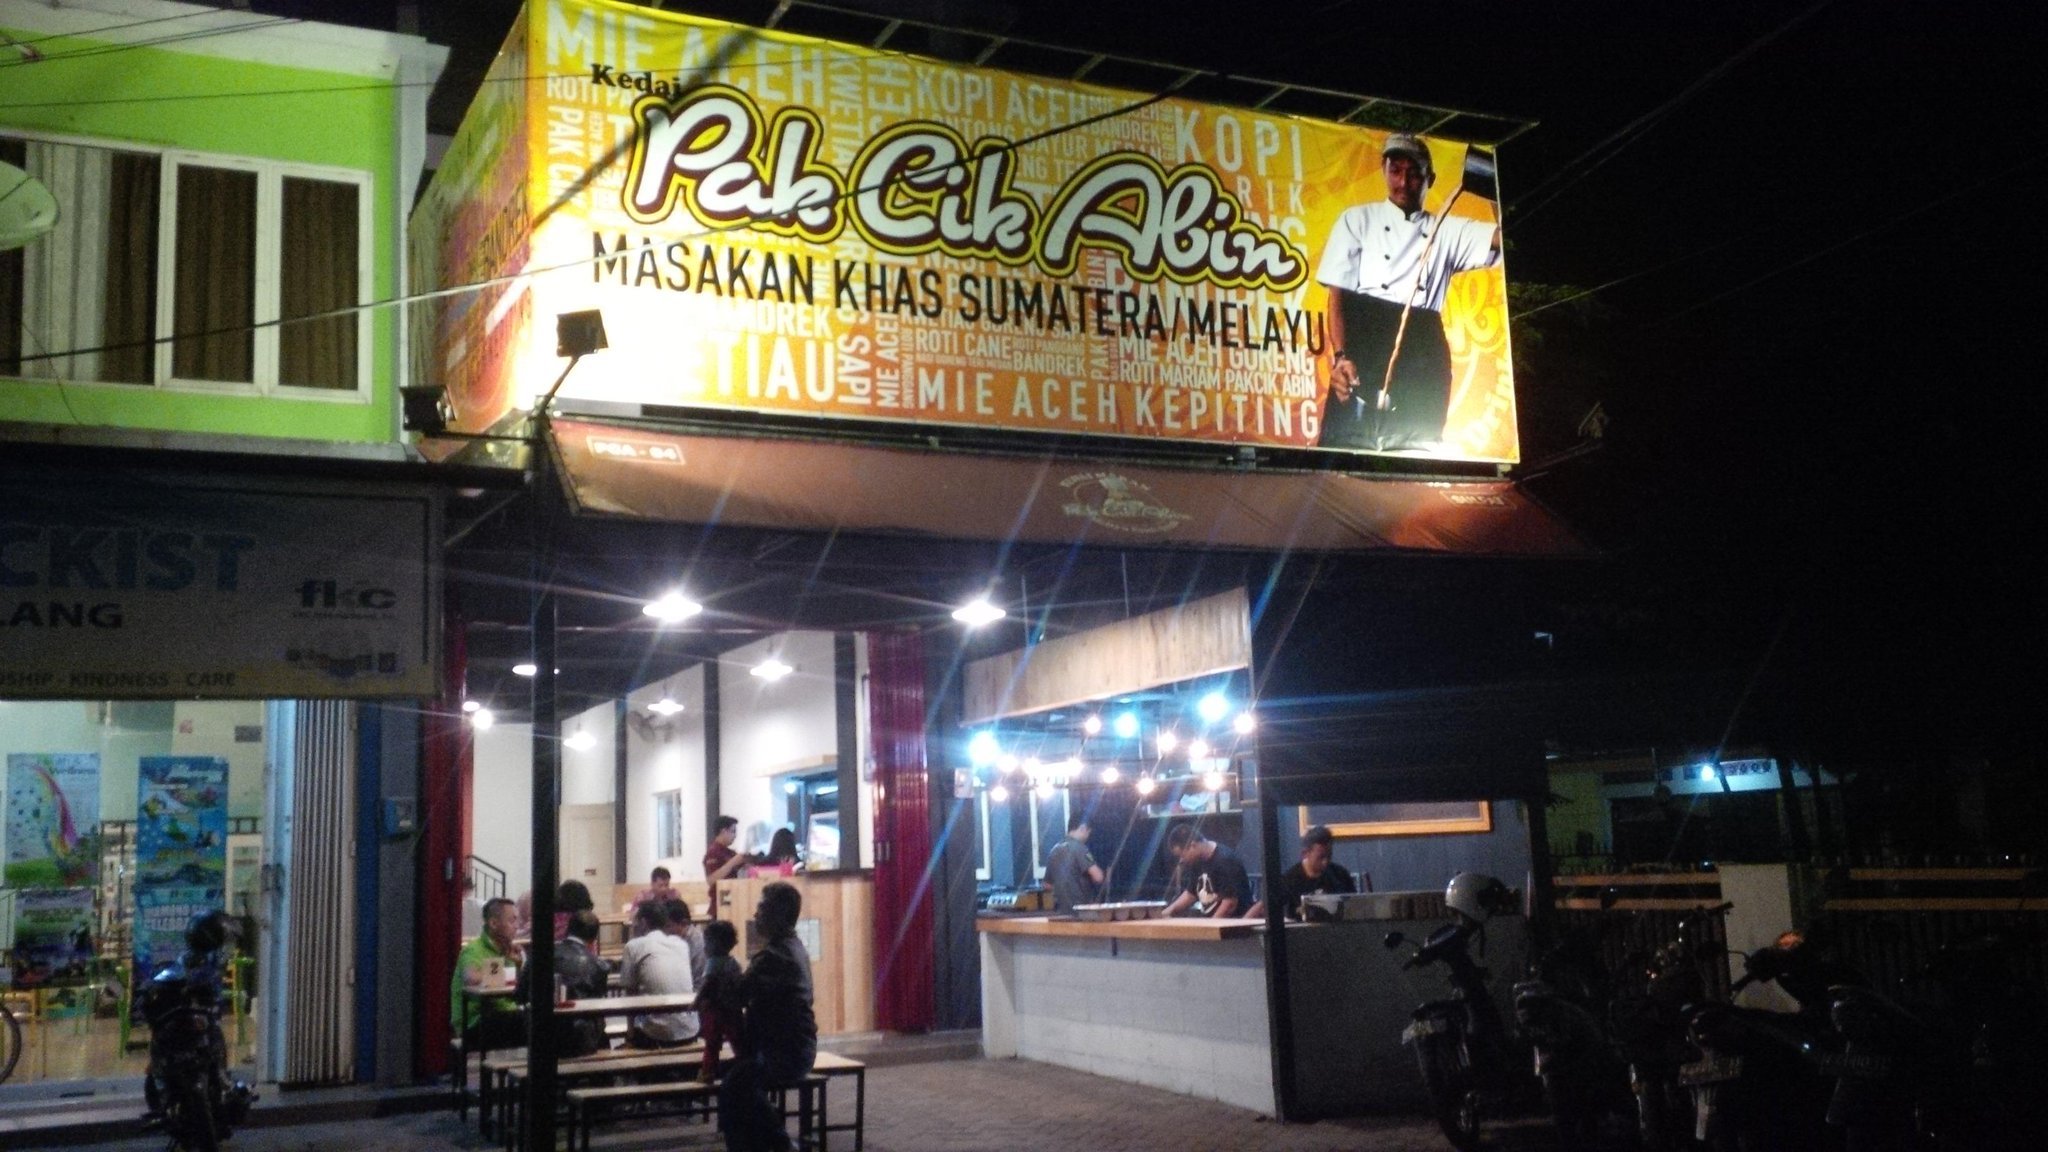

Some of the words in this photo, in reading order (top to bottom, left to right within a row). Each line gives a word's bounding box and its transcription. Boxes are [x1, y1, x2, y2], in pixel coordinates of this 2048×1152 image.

[546, 7, 654, 73] MIE
[591, 63, 681, 99] Kedai
[915, 65, 994, 120] KOPI
[1005, 79, 1087, 127] ACEH
[1174, 105, 1303, 182] KOPI
[629, 91, 839, 229] Pak
[854, 132, 1031, 251] Cik
[1039, 158, 1298, 281] Abin
[592, 231, 814, 306] MASAKAN
[834, 259, 943, 319] KHAS
[958, 272, 1325, 354] SUMATERA/MELAYU
[837, 332, 873, 405] SAPI
[915, 328, 958, 354] ROTI
[964, 332, 1013, 360] CANE
[1013, 351, 1087, 378] BANDREK
[1119, 332, 1159, 364] MIE
[1166, 331, 1222, 369] ACEH
[1229, 340, 1316, 377] GORENG
[876, 366, 900, 408] MIE
[918, 366, 995, 415] MIE
[1012, 376, 1118, 425] ACEH
[1135, 386, 1319, 439] KEPITING
[1119, 360, 1155, 385] ROTI
[1160, 363, 1222, 390] MARIAM
[1225, 370, 1278, 396] PAKCIK
[1282, 374, 1317, 399] ABIN
[69, 672, 169, 688] KINDNESS
[186, 672, 236, 688] CARE
